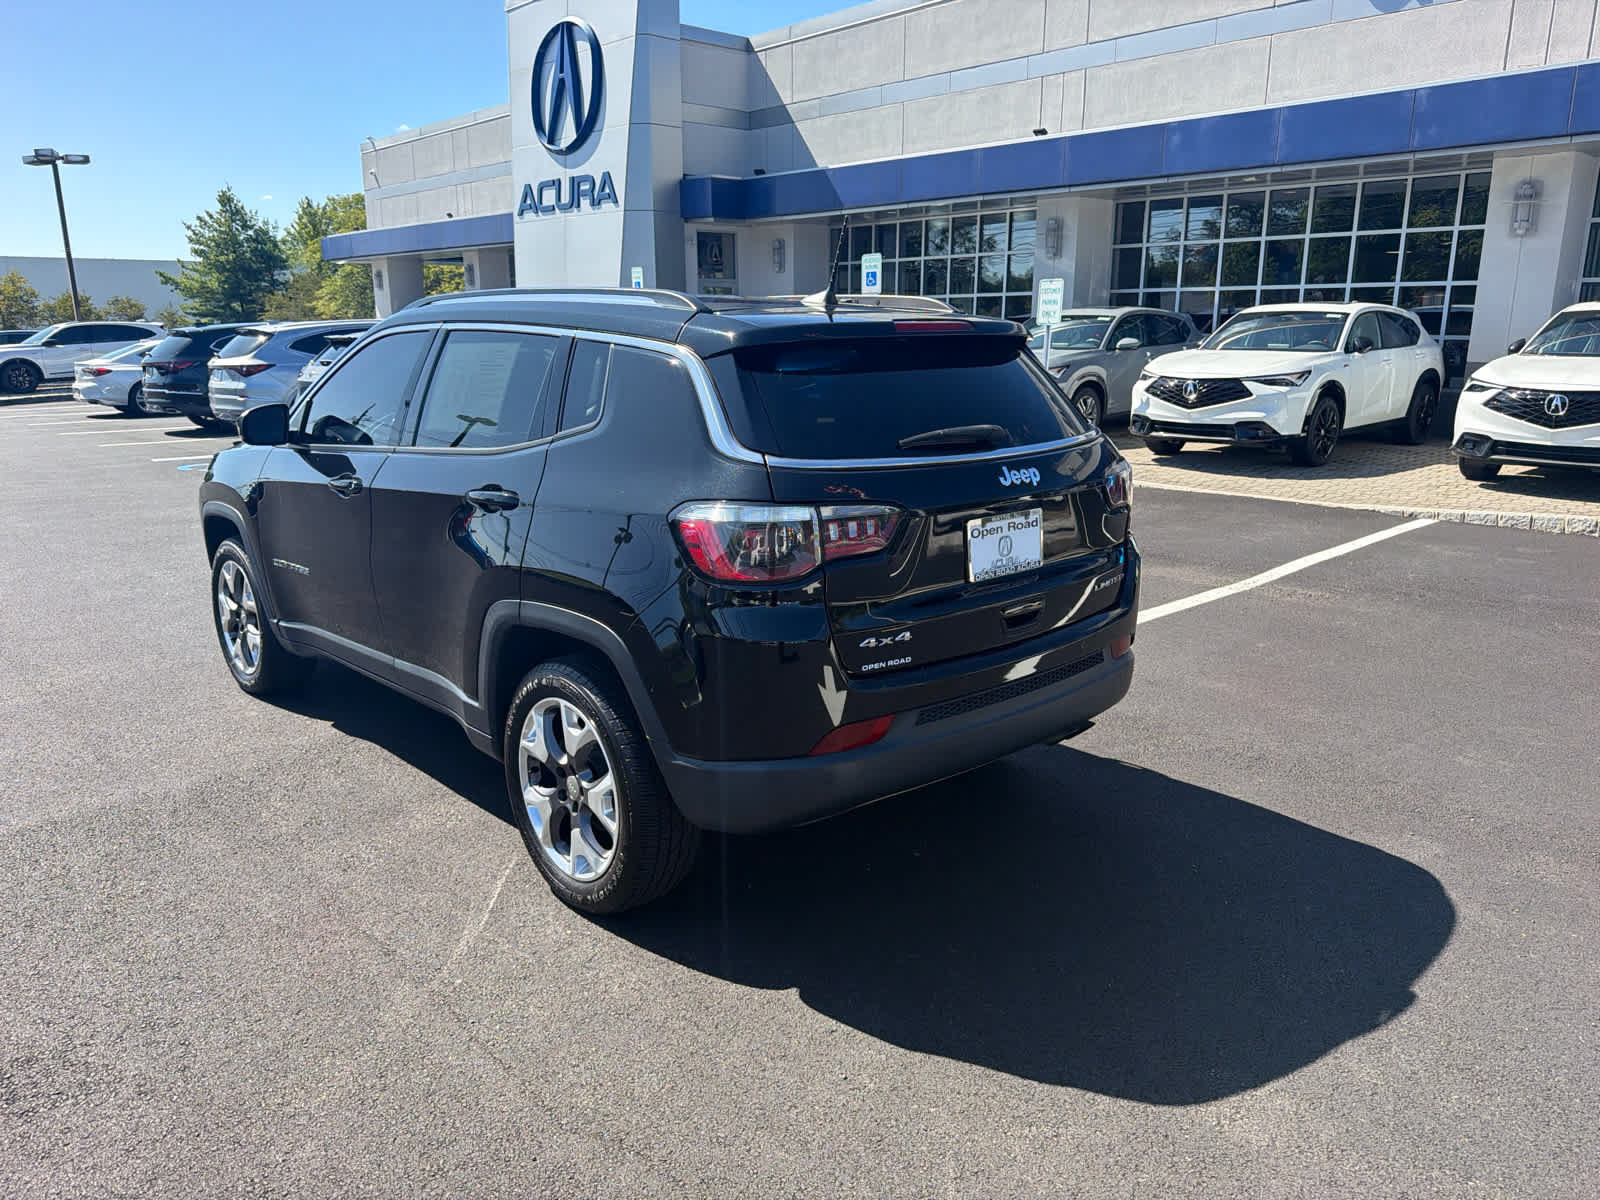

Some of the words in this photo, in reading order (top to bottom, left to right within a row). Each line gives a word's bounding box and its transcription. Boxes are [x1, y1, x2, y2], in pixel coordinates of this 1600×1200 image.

[517, 171, 619, 217] ACURA
[999, 465, 1041, 487] Jeep
[970, 525, 1003, 539] Open
[1007, 517, 1039, 532] Road
[859, 631, 913, 648] 4x4
[861, 660, 887, 672] OPEN
[887, 656, 912, 667] ROAD
